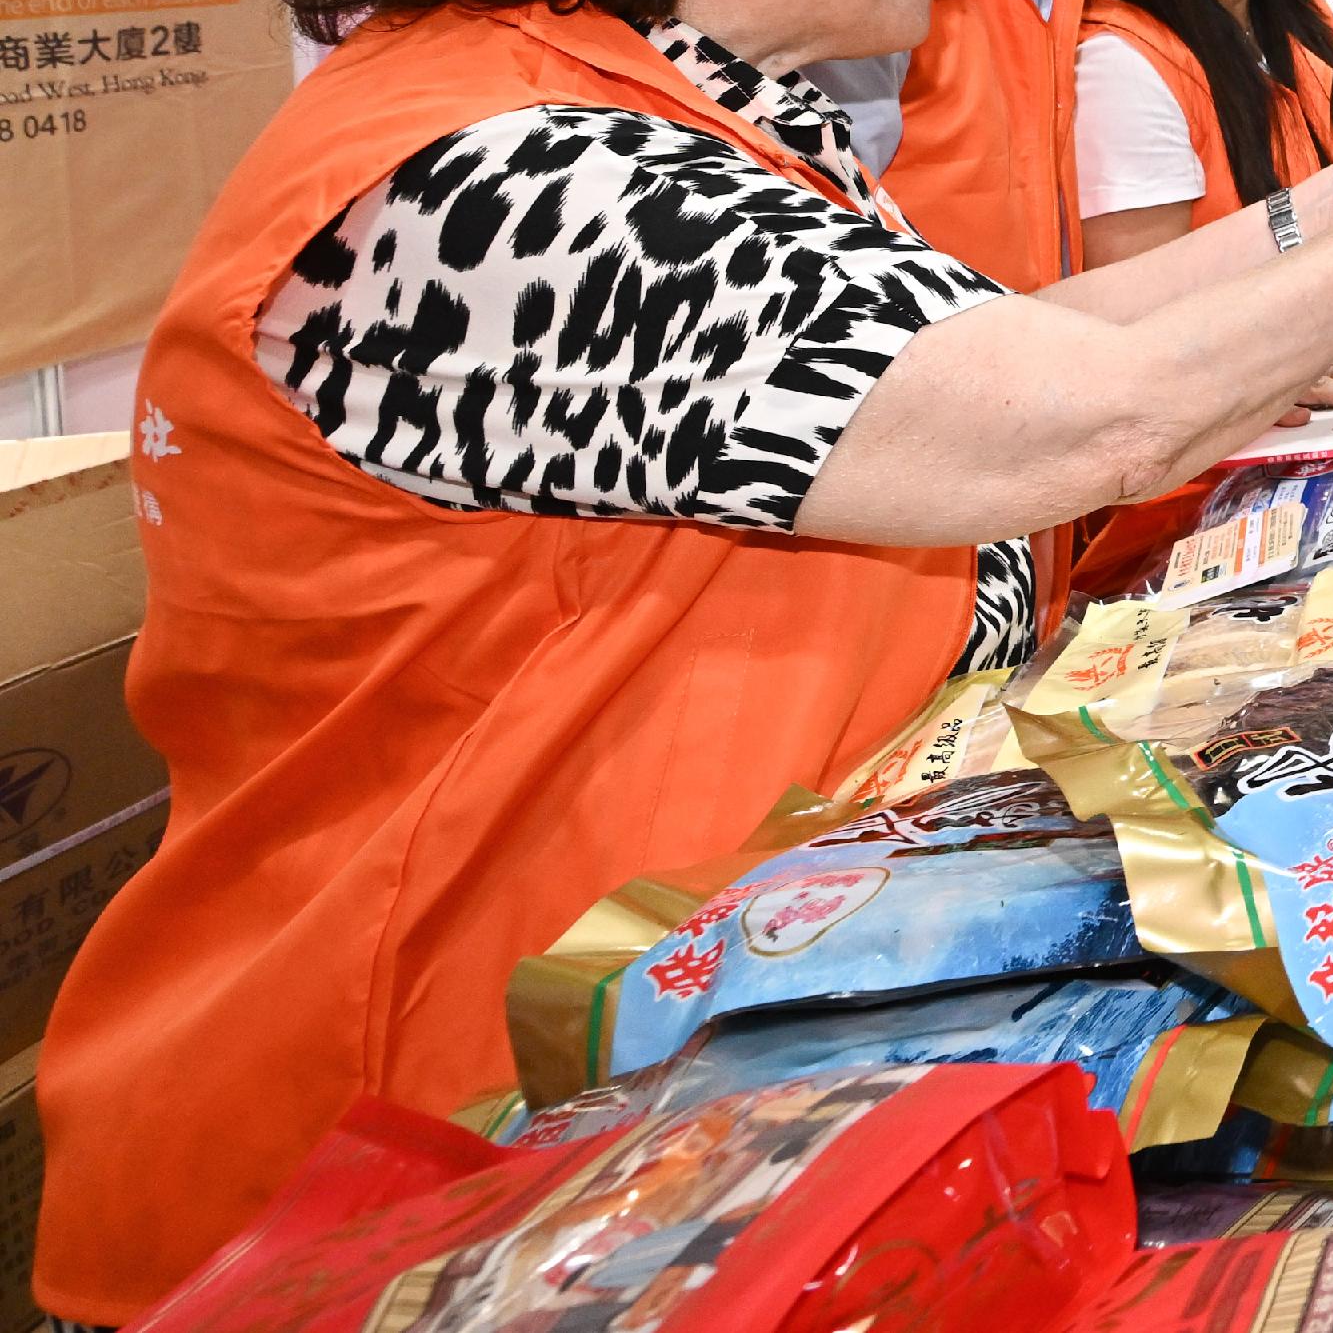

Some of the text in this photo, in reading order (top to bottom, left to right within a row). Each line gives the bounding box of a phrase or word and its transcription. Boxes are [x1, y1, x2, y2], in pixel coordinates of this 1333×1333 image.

[24, 109, 87, 140] 0418
[921, 718, 963, 784] 最高級品
